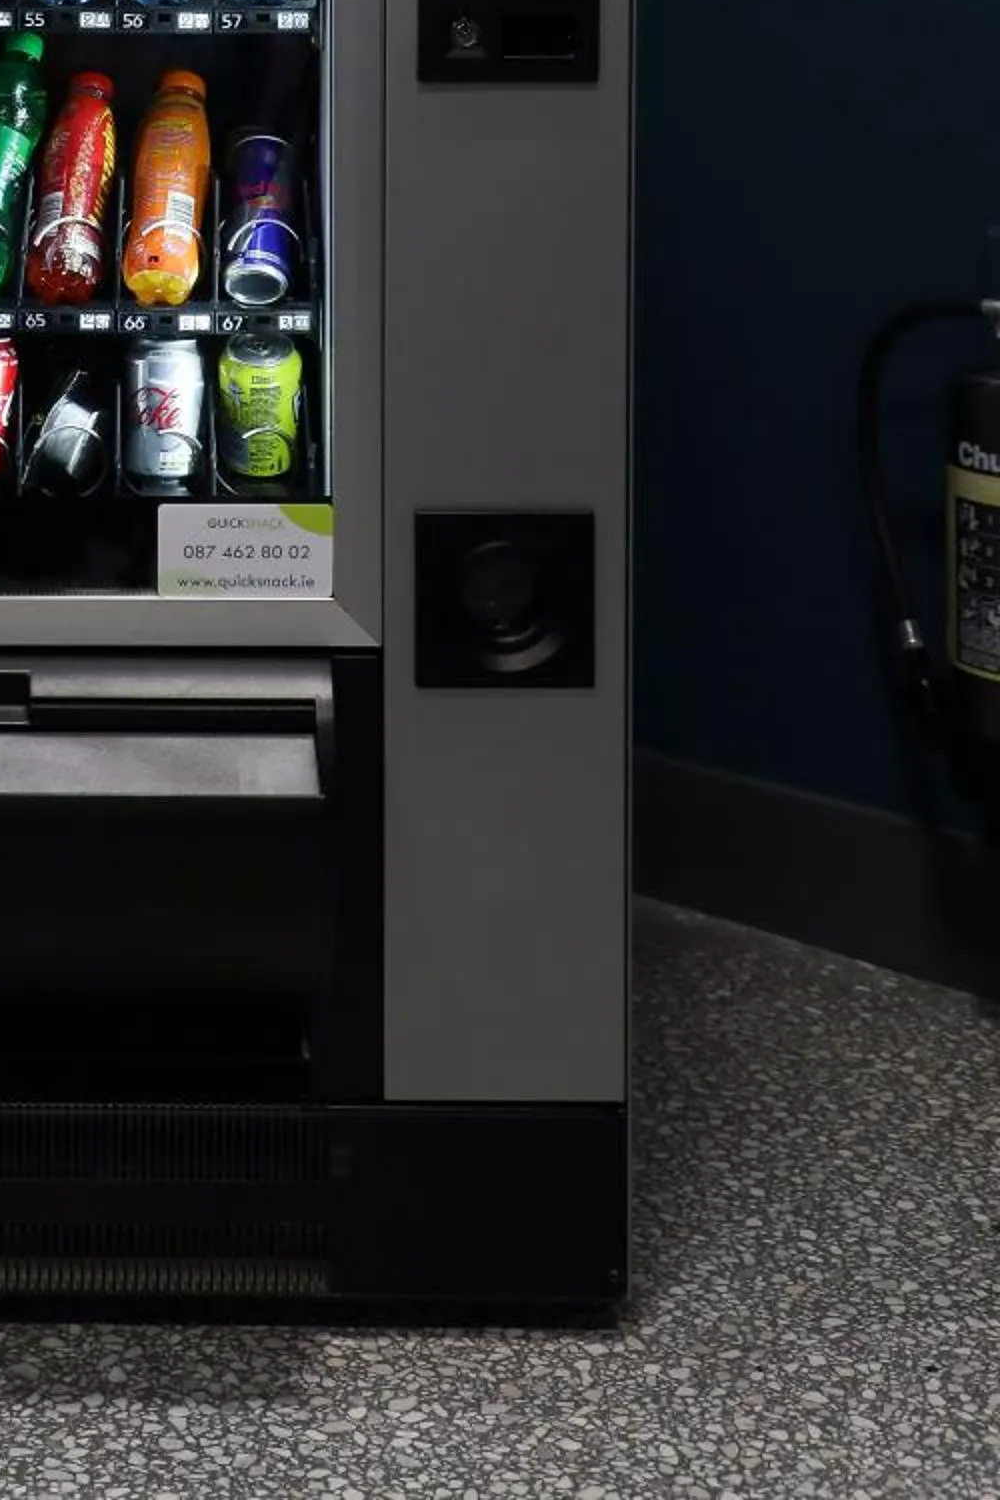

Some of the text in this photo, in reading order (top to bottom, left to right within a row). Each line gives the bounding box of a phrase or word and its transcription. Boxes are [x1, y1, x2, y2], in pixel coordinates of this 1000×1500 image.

[25, 13, 44, 26] 55
[123, 14, 143, 28] 56
[222, 14, 241, 28] 57
[26, 314, 46, 328] 65
[124, 316, 144, 330] 66
[223, 316, 242, 330] 67
[206, 517, 284, 529] QUICKSNACK
[183, 545, 311, 560] 087 462 80 02
[177, 574, 316, 590] www.quicksnack.ie
